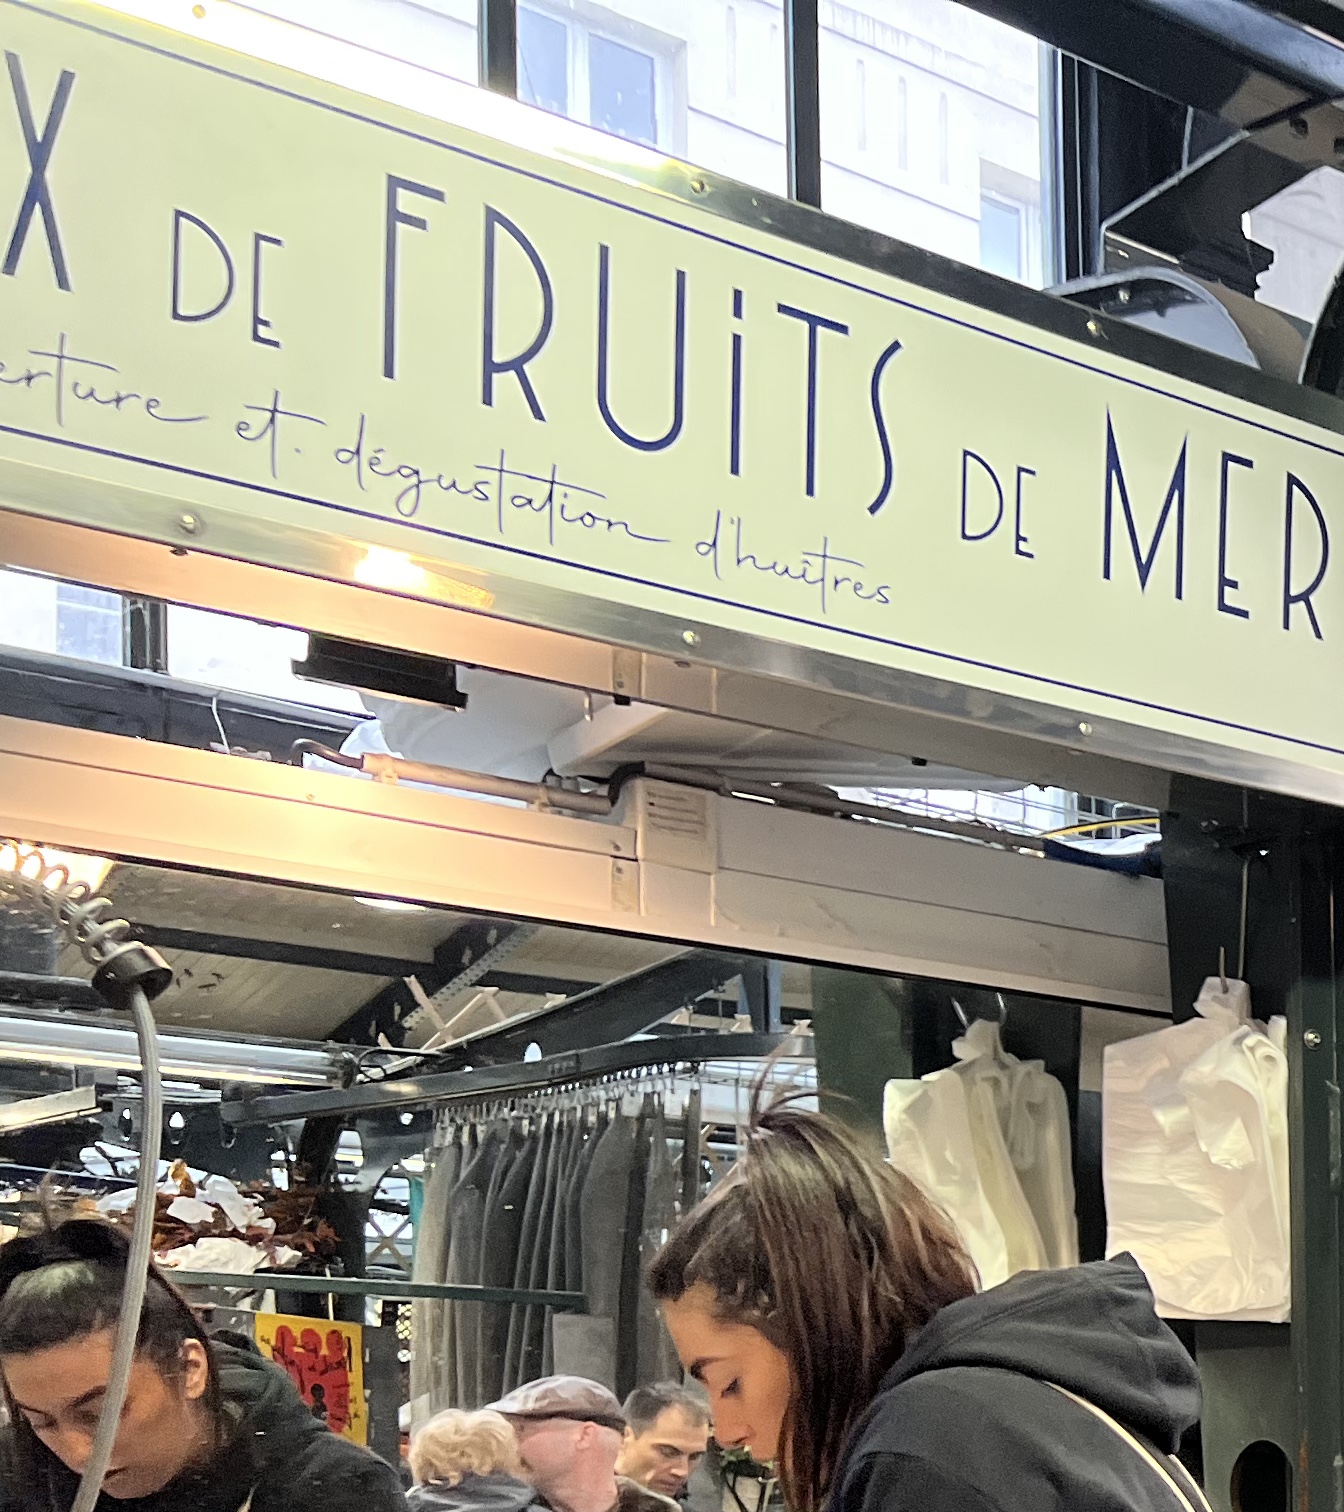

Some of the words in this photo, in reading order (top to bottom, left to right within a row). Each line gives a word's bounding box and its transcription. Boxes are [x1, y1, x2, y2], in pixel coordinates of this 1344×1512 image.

[172, 208, 284, 349] DE
[961, 449, 1037, 559] DE
[1103, 404, 1329, 641] MER
[335, 413, 671, 546] dégustation
